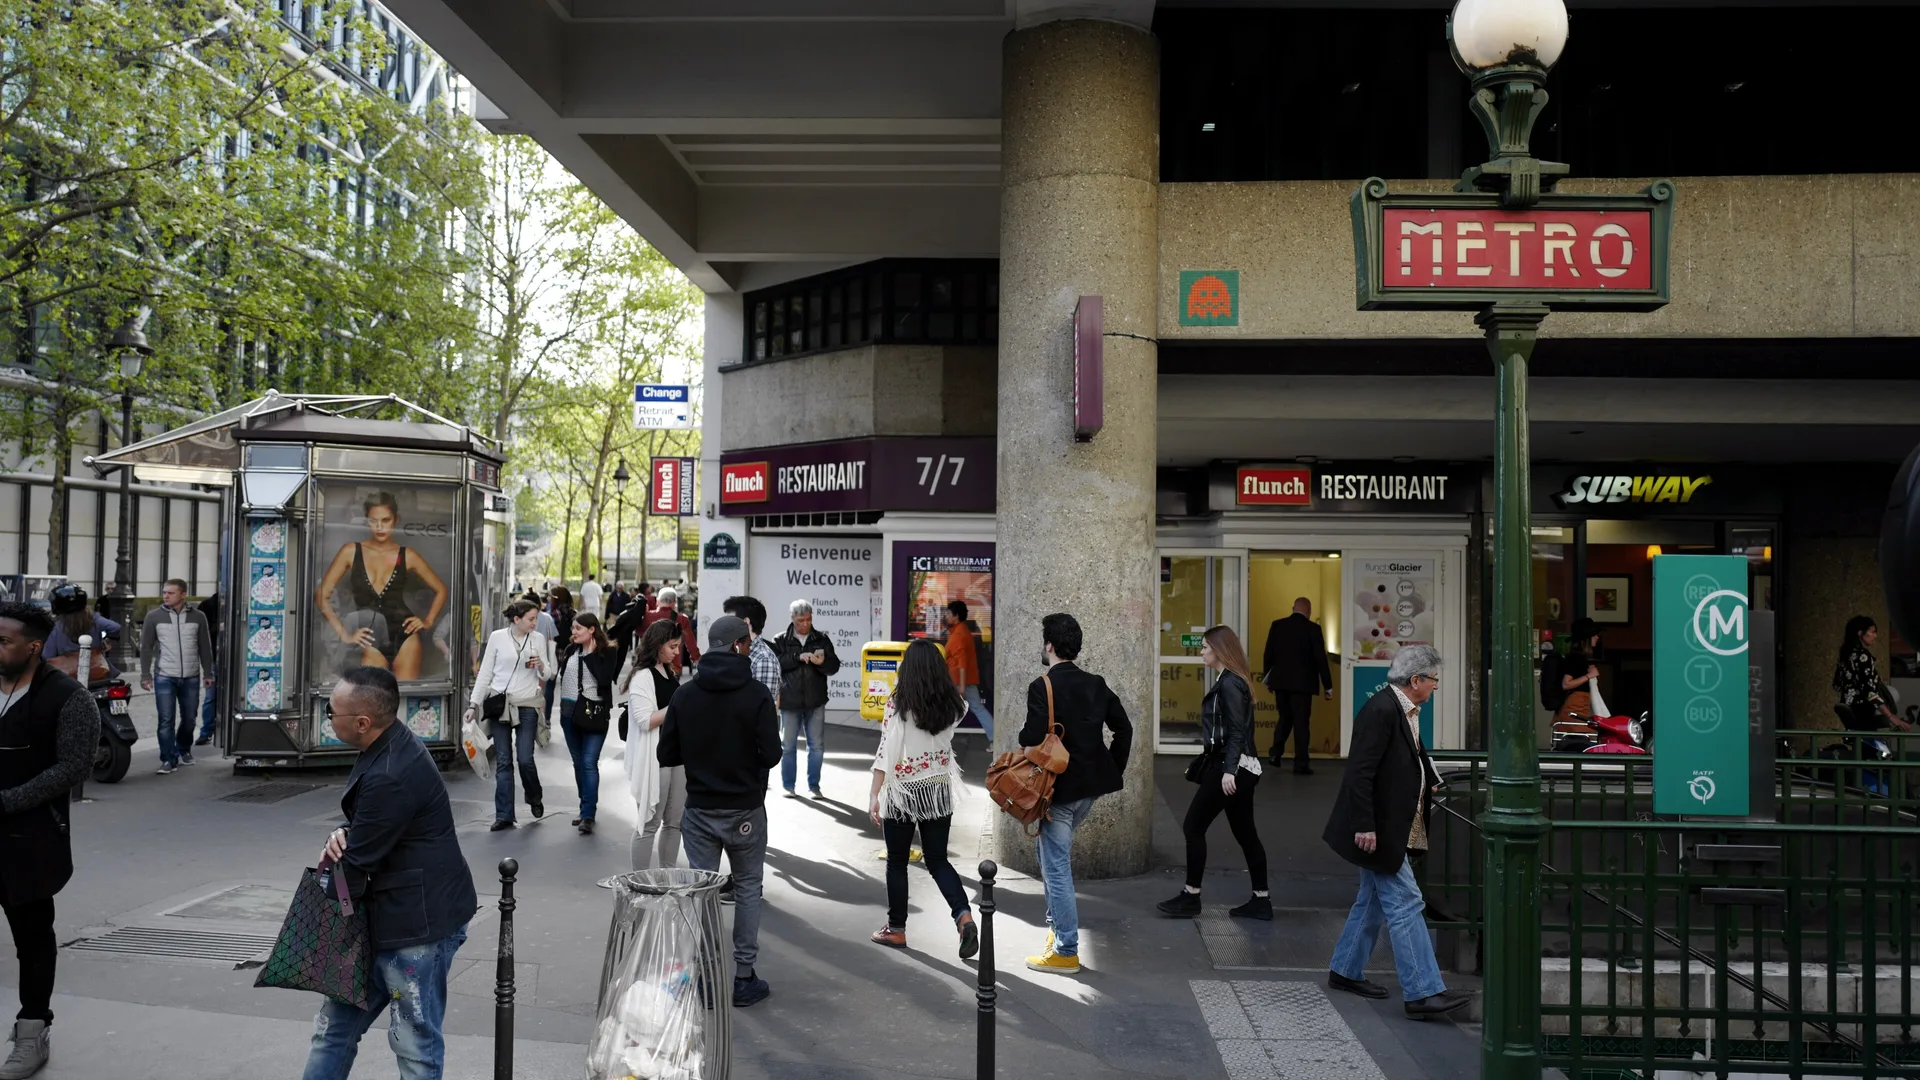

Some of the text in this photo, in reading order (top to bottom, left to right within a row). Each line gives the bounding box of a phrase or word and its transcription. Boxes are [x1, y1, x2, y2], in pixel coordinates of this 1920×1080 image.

[1401, 221, 1634, 278] METRO
[642, 386, 682, 400] Change
[638, 405, 675, 415] Retrait
[638, 416, 663, 426] ATM
[725, 460, 866, 494] flunch RESTAURANT
[916, 454, 965, 496] 7/7
[657, 463, 673, 510] flunch
[681, 461, 693, 513] RESTAURANT
[1243, 475, 1448, 500] flunch RESTAURANT
[1561, 475, 1713, 504] SUBWAY
[403, 522, 448, 538] ERES
[781, 543, 872, 561] Bienvenue
[938, 557, 992, 566] RESTAURANT
[787, 569, 864, 586] Welcome
[812, 598, 838, 607] Flunch
[816, 608, 860, 617] Restaurant
[1709, 604, 1744, 641] M
[838, 629, 859, 639] Open
[836, 639, 852, 647] 22h
[1694, 664, 1712, 685] T
[831, 679, 851, 688] Plats
[1690, 707, 1717, 722] BUS
